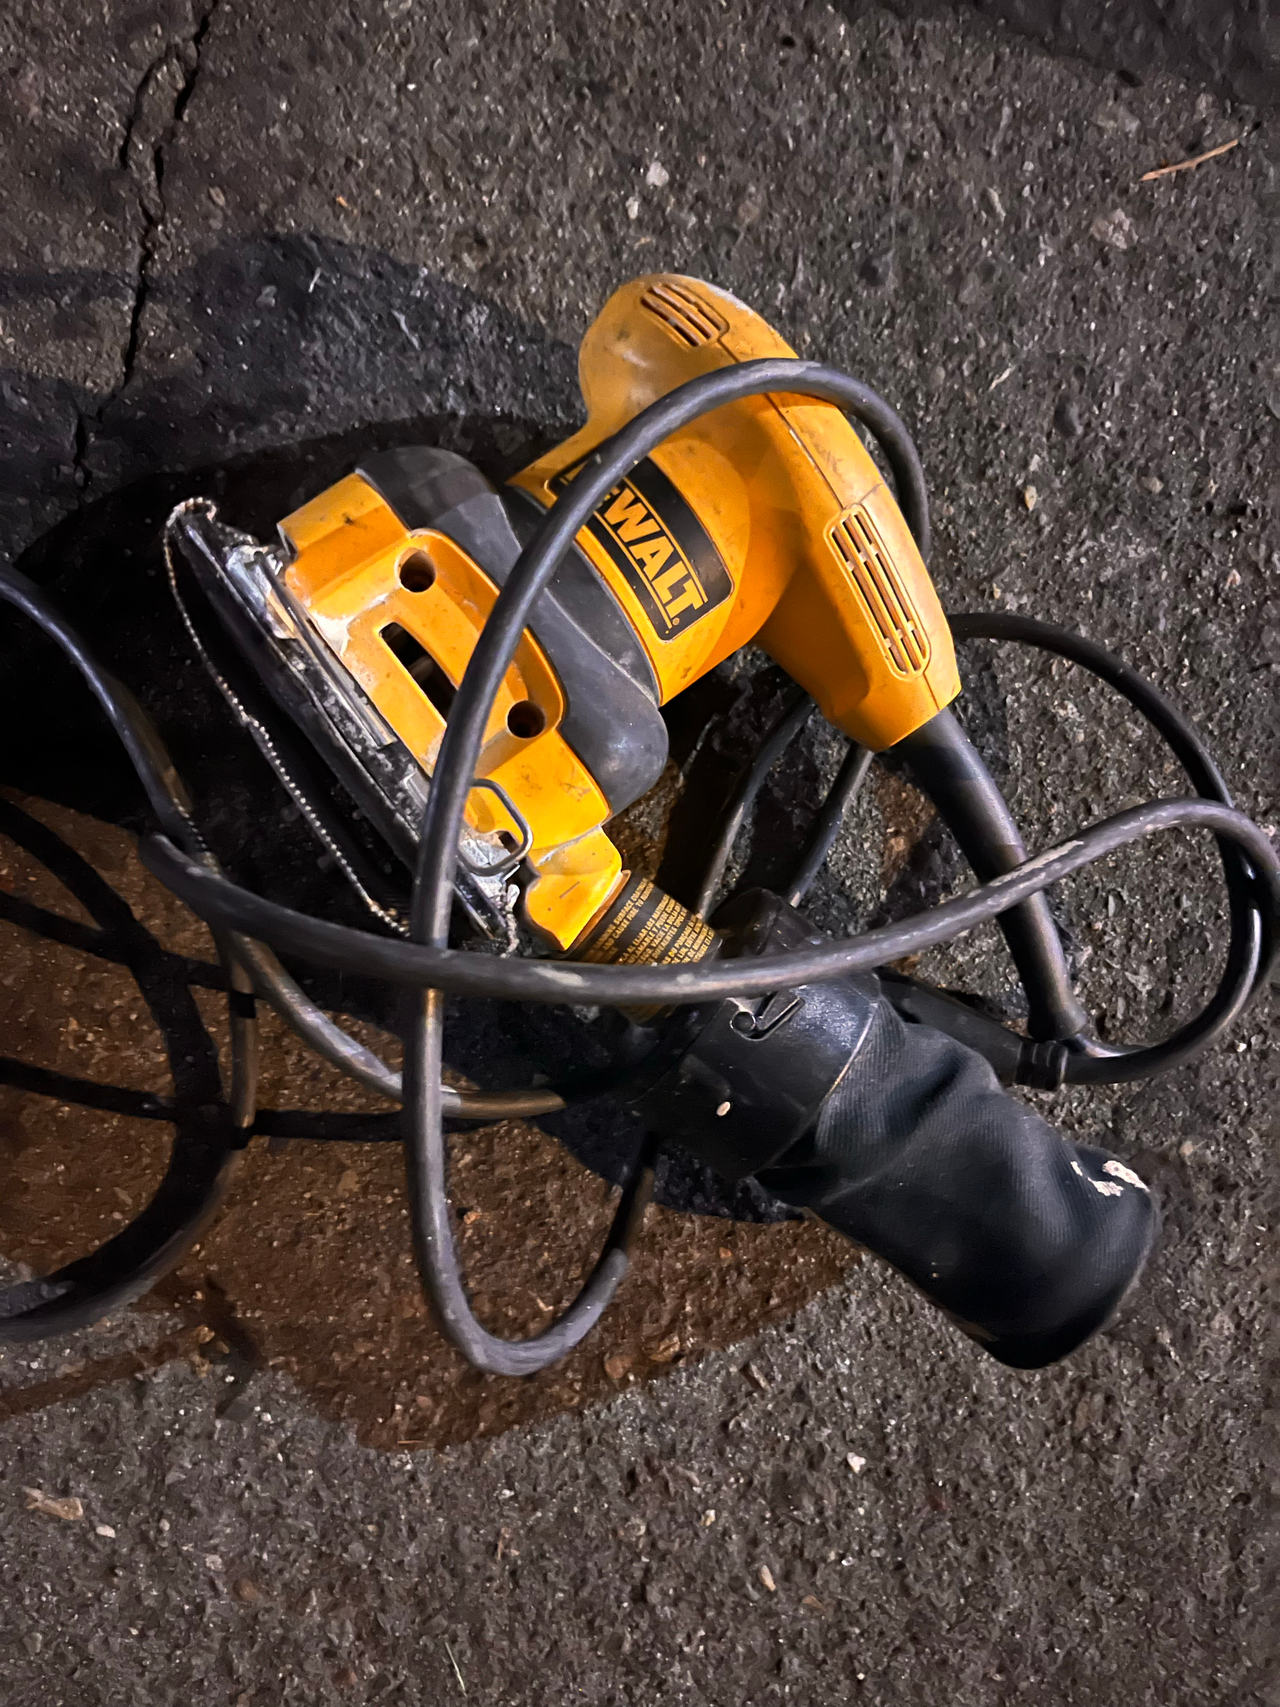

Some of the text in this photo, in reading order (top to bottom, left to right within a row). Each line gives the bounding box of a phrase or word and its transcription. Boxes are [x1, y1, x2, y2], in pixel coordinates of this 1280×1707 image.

[560, 464, 703, 619] WALT
[602, 937, 615, 951] AND
[611, 918, 629, 939] CAUSE
[635, 898, 643, 907] TO
[612, 899, 634, 925] SURFACE
[661, 921, 670, 931] LA
[626, 944, 635, 953] AL
[632, 928, 647, 946] LIJAR
[644, 917, 655, 930] LOS
[627, 930, 655, 965] NFLAMABLE
[651, 925, 677, 959] DIFERENTES
